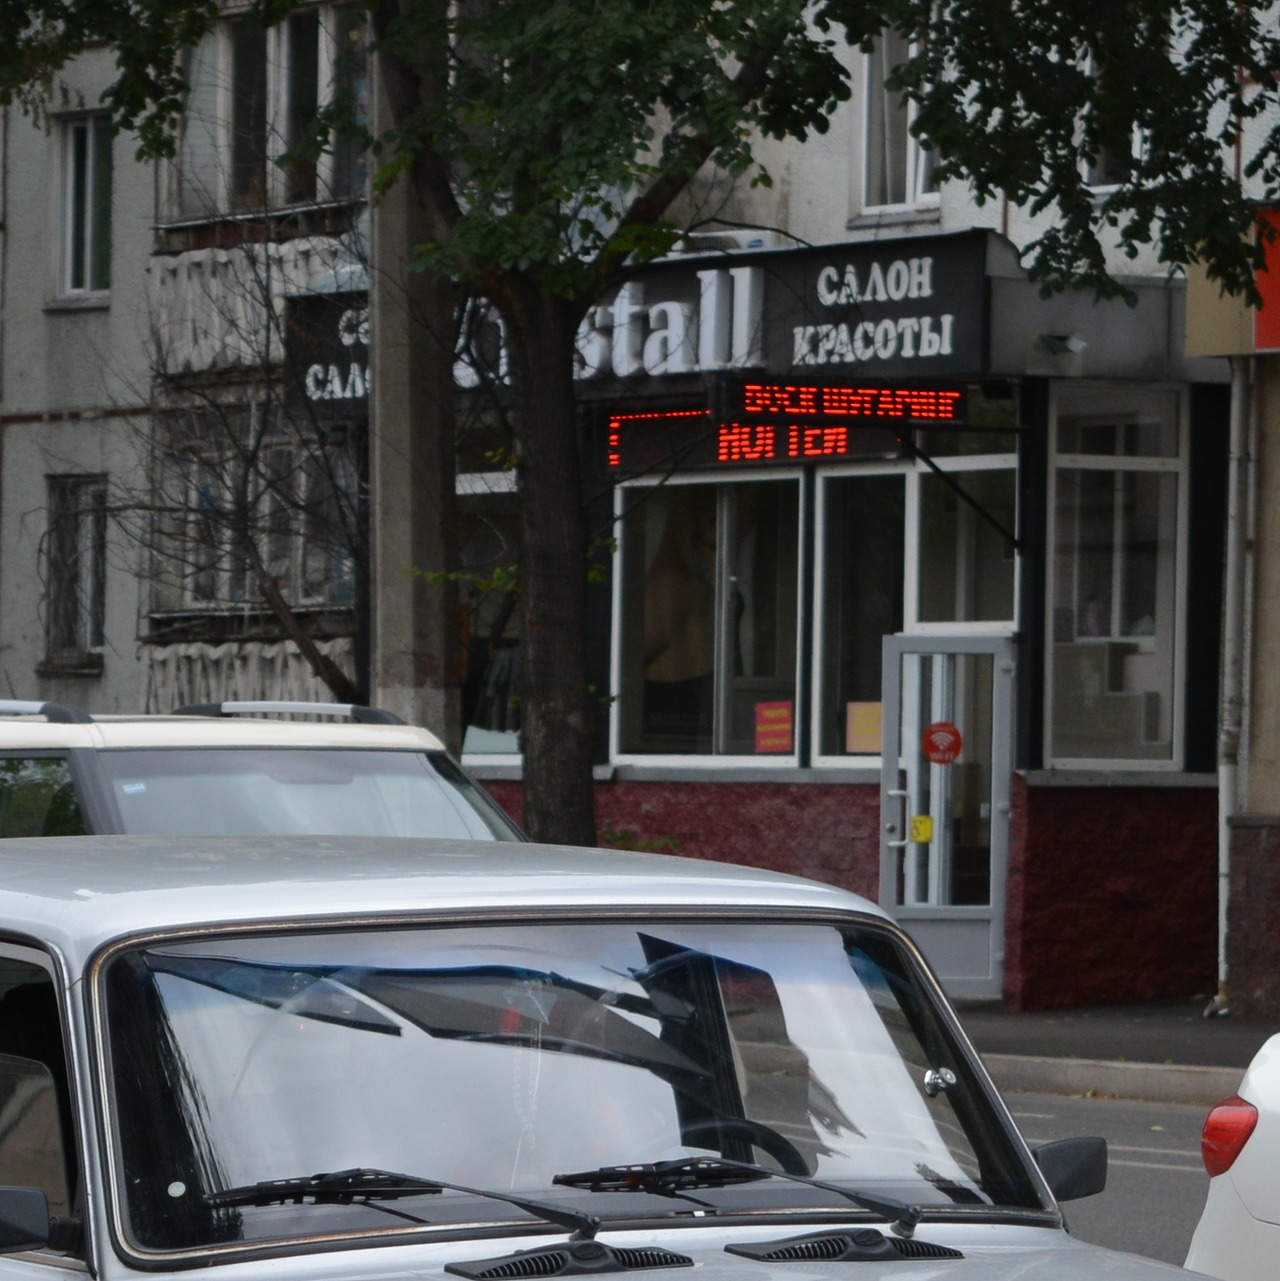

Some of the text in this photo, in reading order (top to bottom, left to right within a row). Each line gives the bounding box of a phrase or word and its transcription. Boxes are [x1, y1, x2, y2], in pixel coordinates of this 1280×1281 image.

[816, 256, 934, 306] САЛОН
[791, 313, 955, 367] КРАСОТЫ
[305, 362, 370, 401] САЛ
